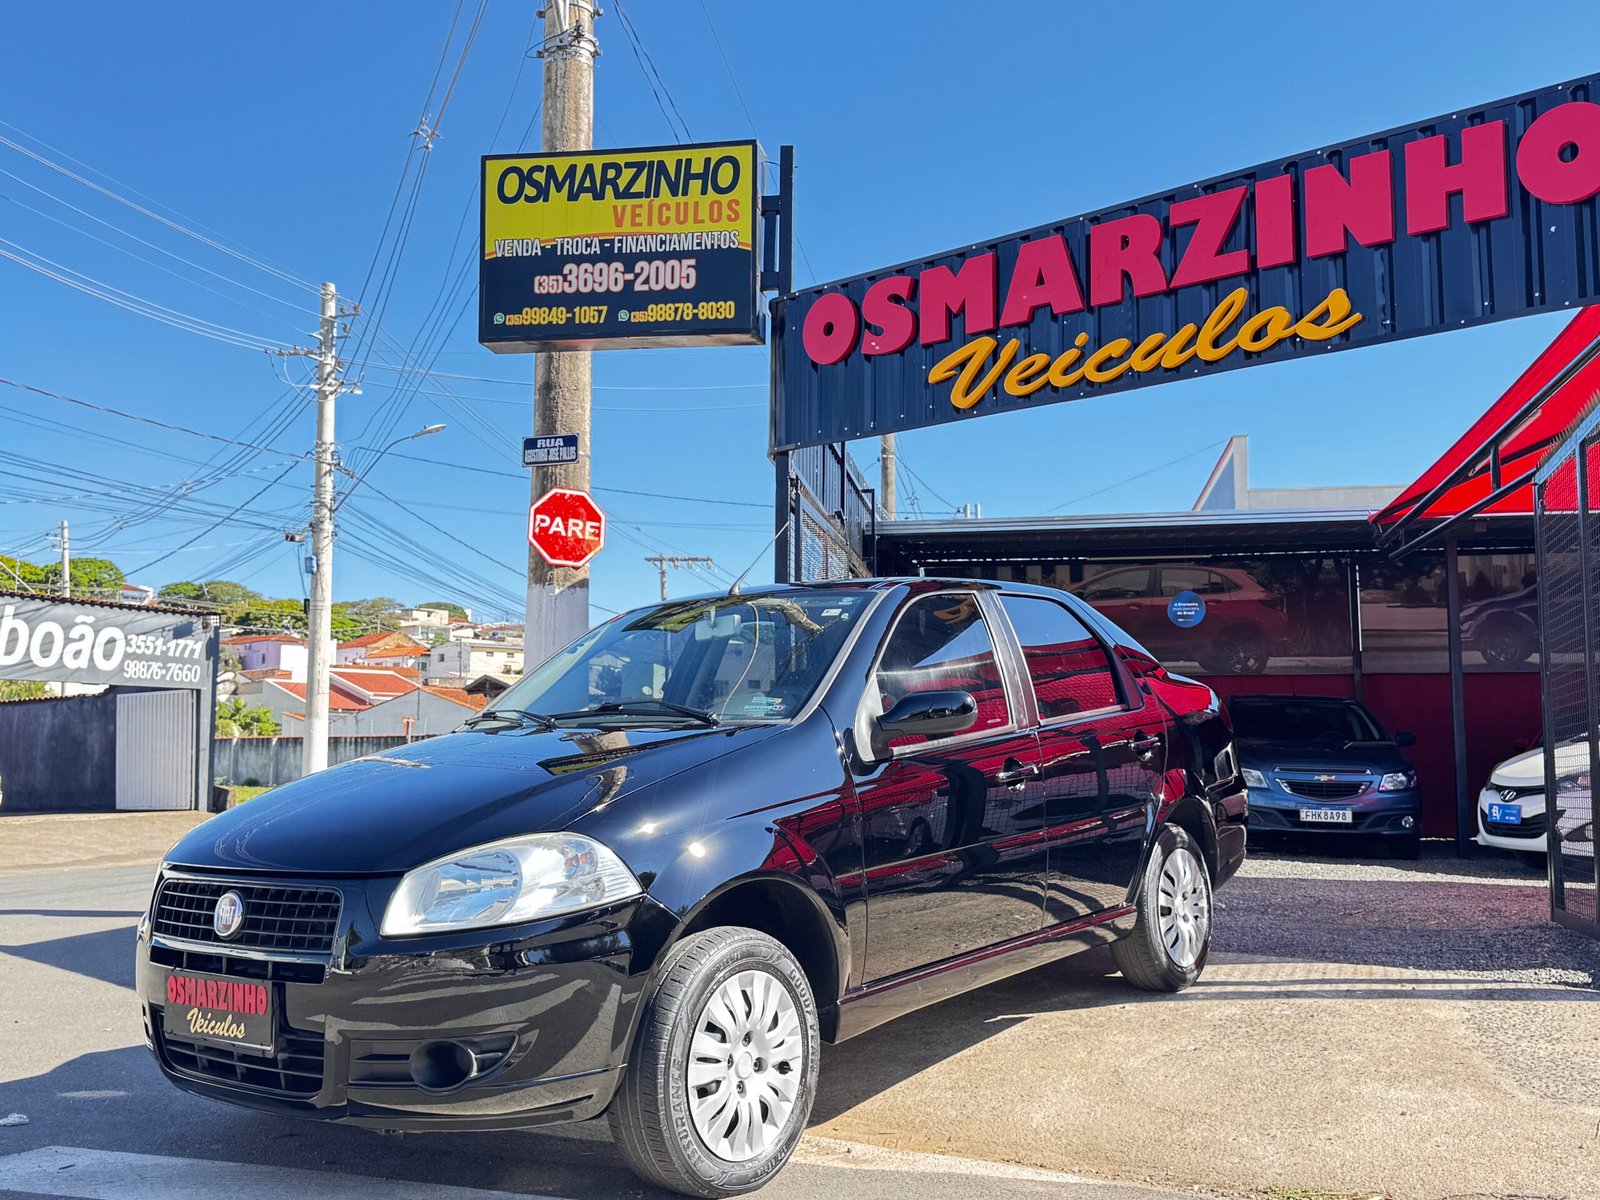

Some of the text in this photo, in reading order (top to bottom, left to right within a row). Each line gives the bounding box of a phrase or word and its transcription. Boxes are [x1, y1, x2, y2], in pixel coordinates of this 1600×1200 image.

[496, 155, 741, 205] OSMARZINHO
[611, 199, 741, 228] VEÍCULOS
[494, 238, 542, 258] VENDA
[554, 236, 601, 256] TROCA
[613, 230, 740, 254] FINANCIAMENTOS
[802, 101, 1600, 366] OSMARZINHO
[927, 287, 1362, 410] Veiculos
[537, 438, 564, 447] RUA
[534, 514, 601, 541] PARE
[0, 605, 126, 671] boão
[1305, 810, 1347, 821] FHK8A98
[167, 975, 269, 1016] OSMARZINHO
